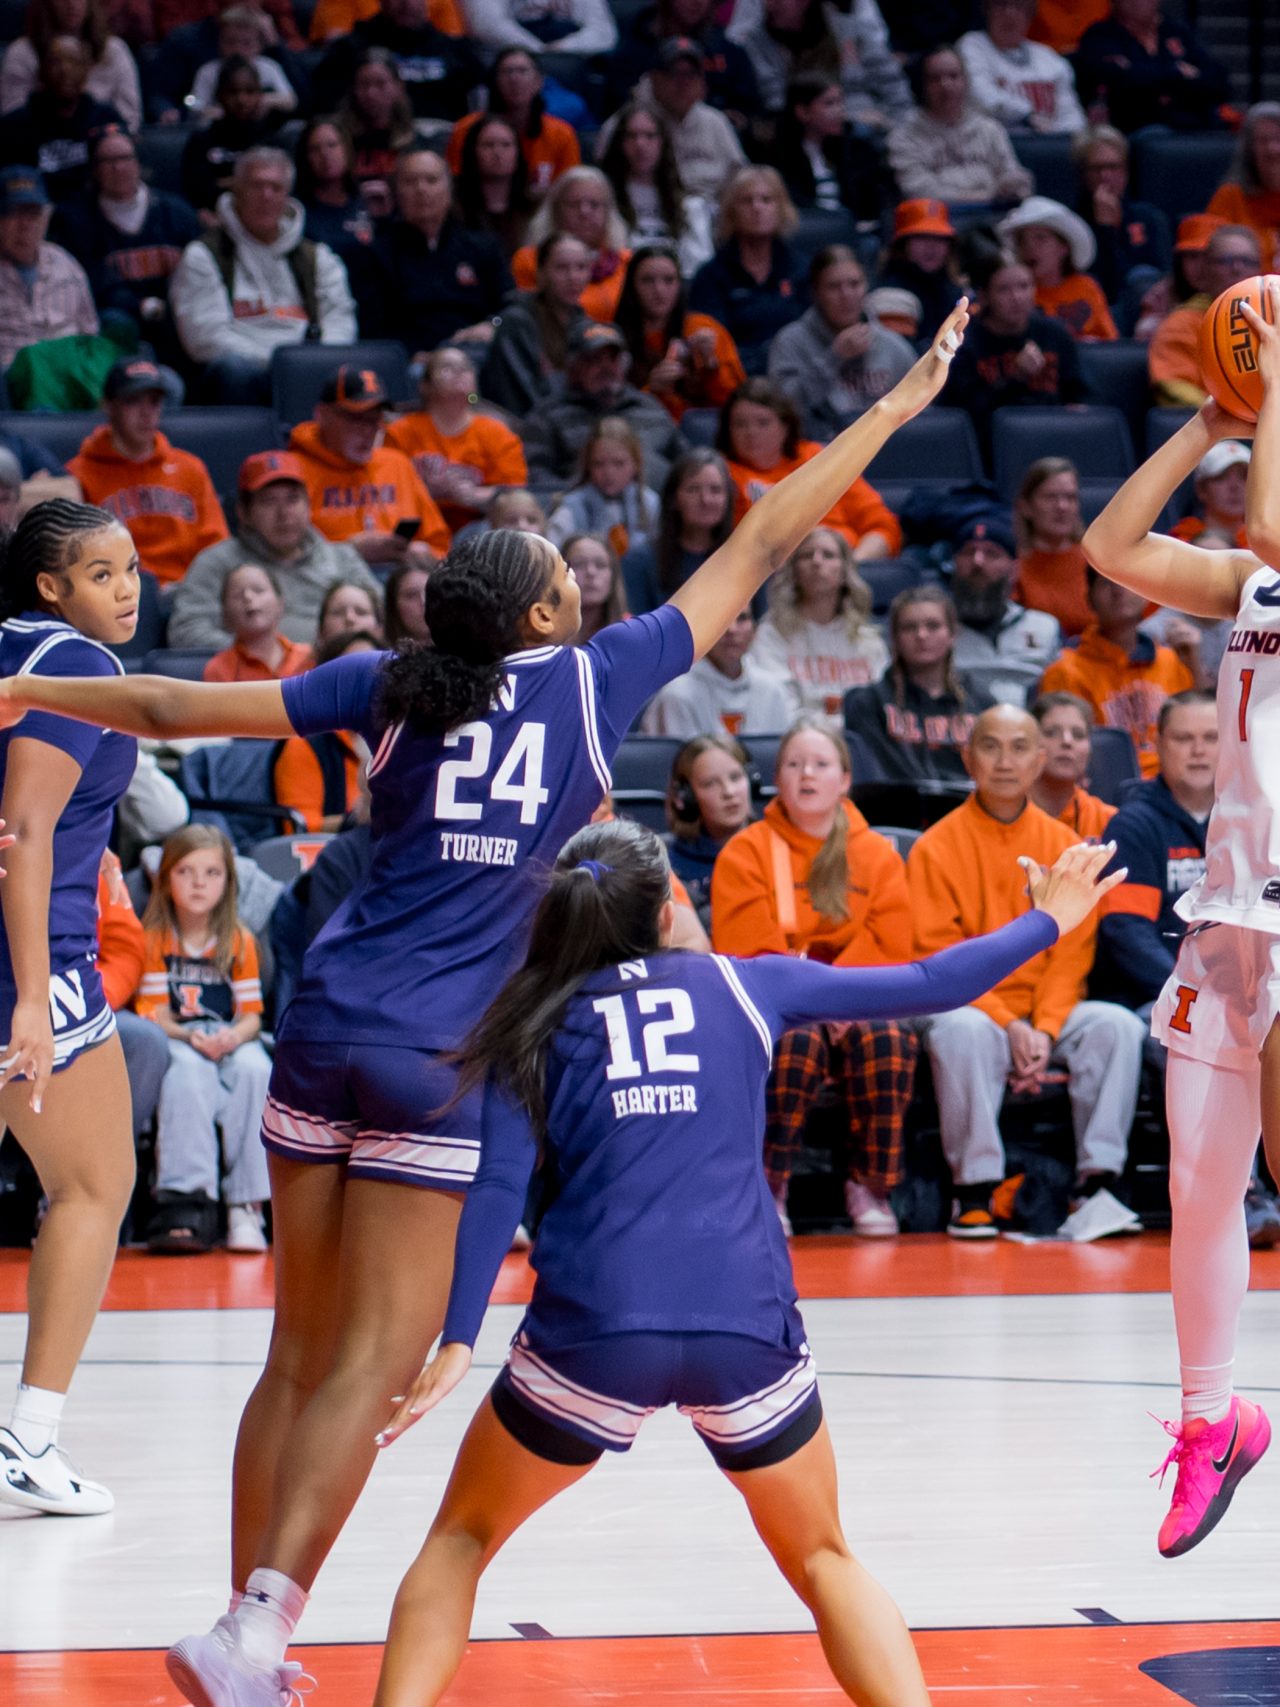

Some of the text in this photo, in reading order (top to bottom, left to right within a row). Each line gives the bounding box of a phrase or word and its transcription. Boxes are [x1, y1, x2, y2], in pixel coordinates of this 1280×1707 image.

[1239, 669, 1255, 742] 1
[435, 721, 549, 825] 24
[440, 832, 518, 866] TURNER
[618, 959, 649, 981] N
[49, 968, 87, 1030] N
[179, 985, 205, 1017] I
[1169, 984, 1199, 1034] I
[592, 988, 700, 1080] 12
[612, 1084, 698, 1119] HARTER
